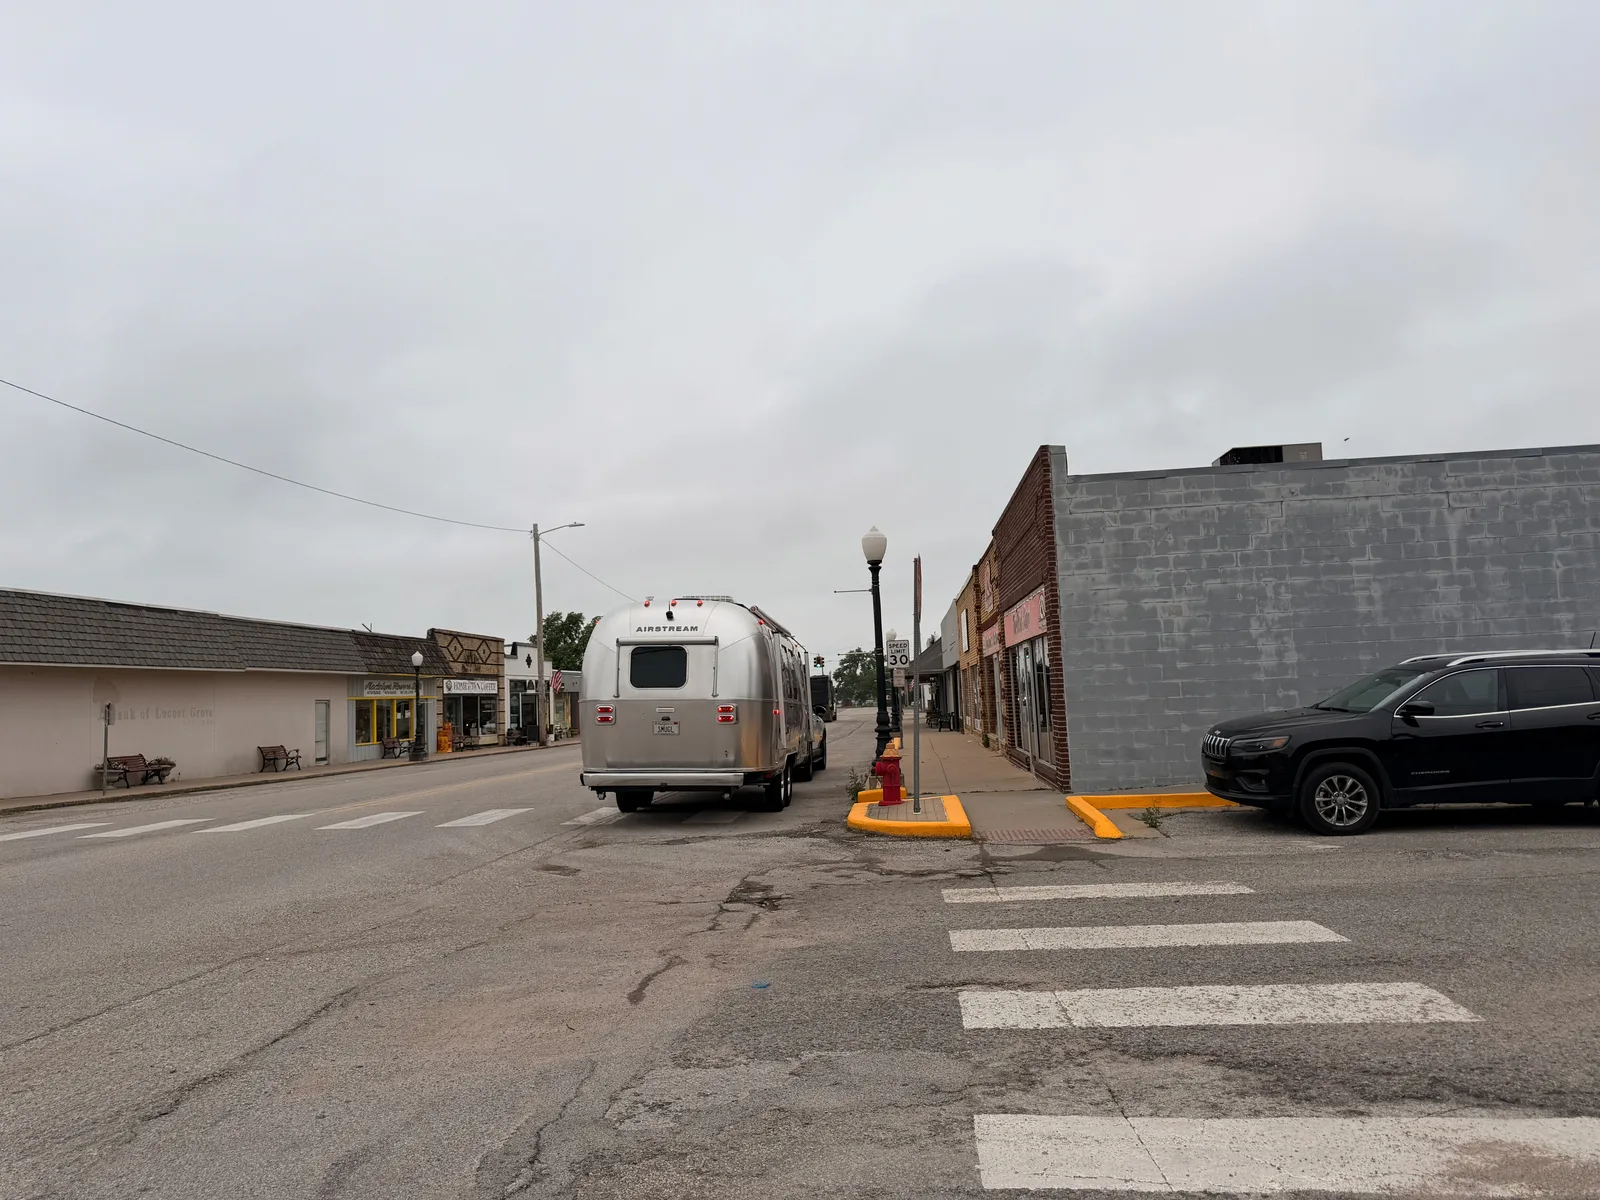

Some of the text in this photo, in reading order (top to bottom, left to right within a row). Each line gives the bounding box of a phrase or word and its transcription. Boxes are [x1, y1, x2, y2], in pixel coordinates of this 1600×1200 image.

[635, 625, 699, 633] AIRSTREAM
[889, 654, 908, 666] 30
[140, 708, 151, 720] of
[190, 707, 214, 718] Grove
